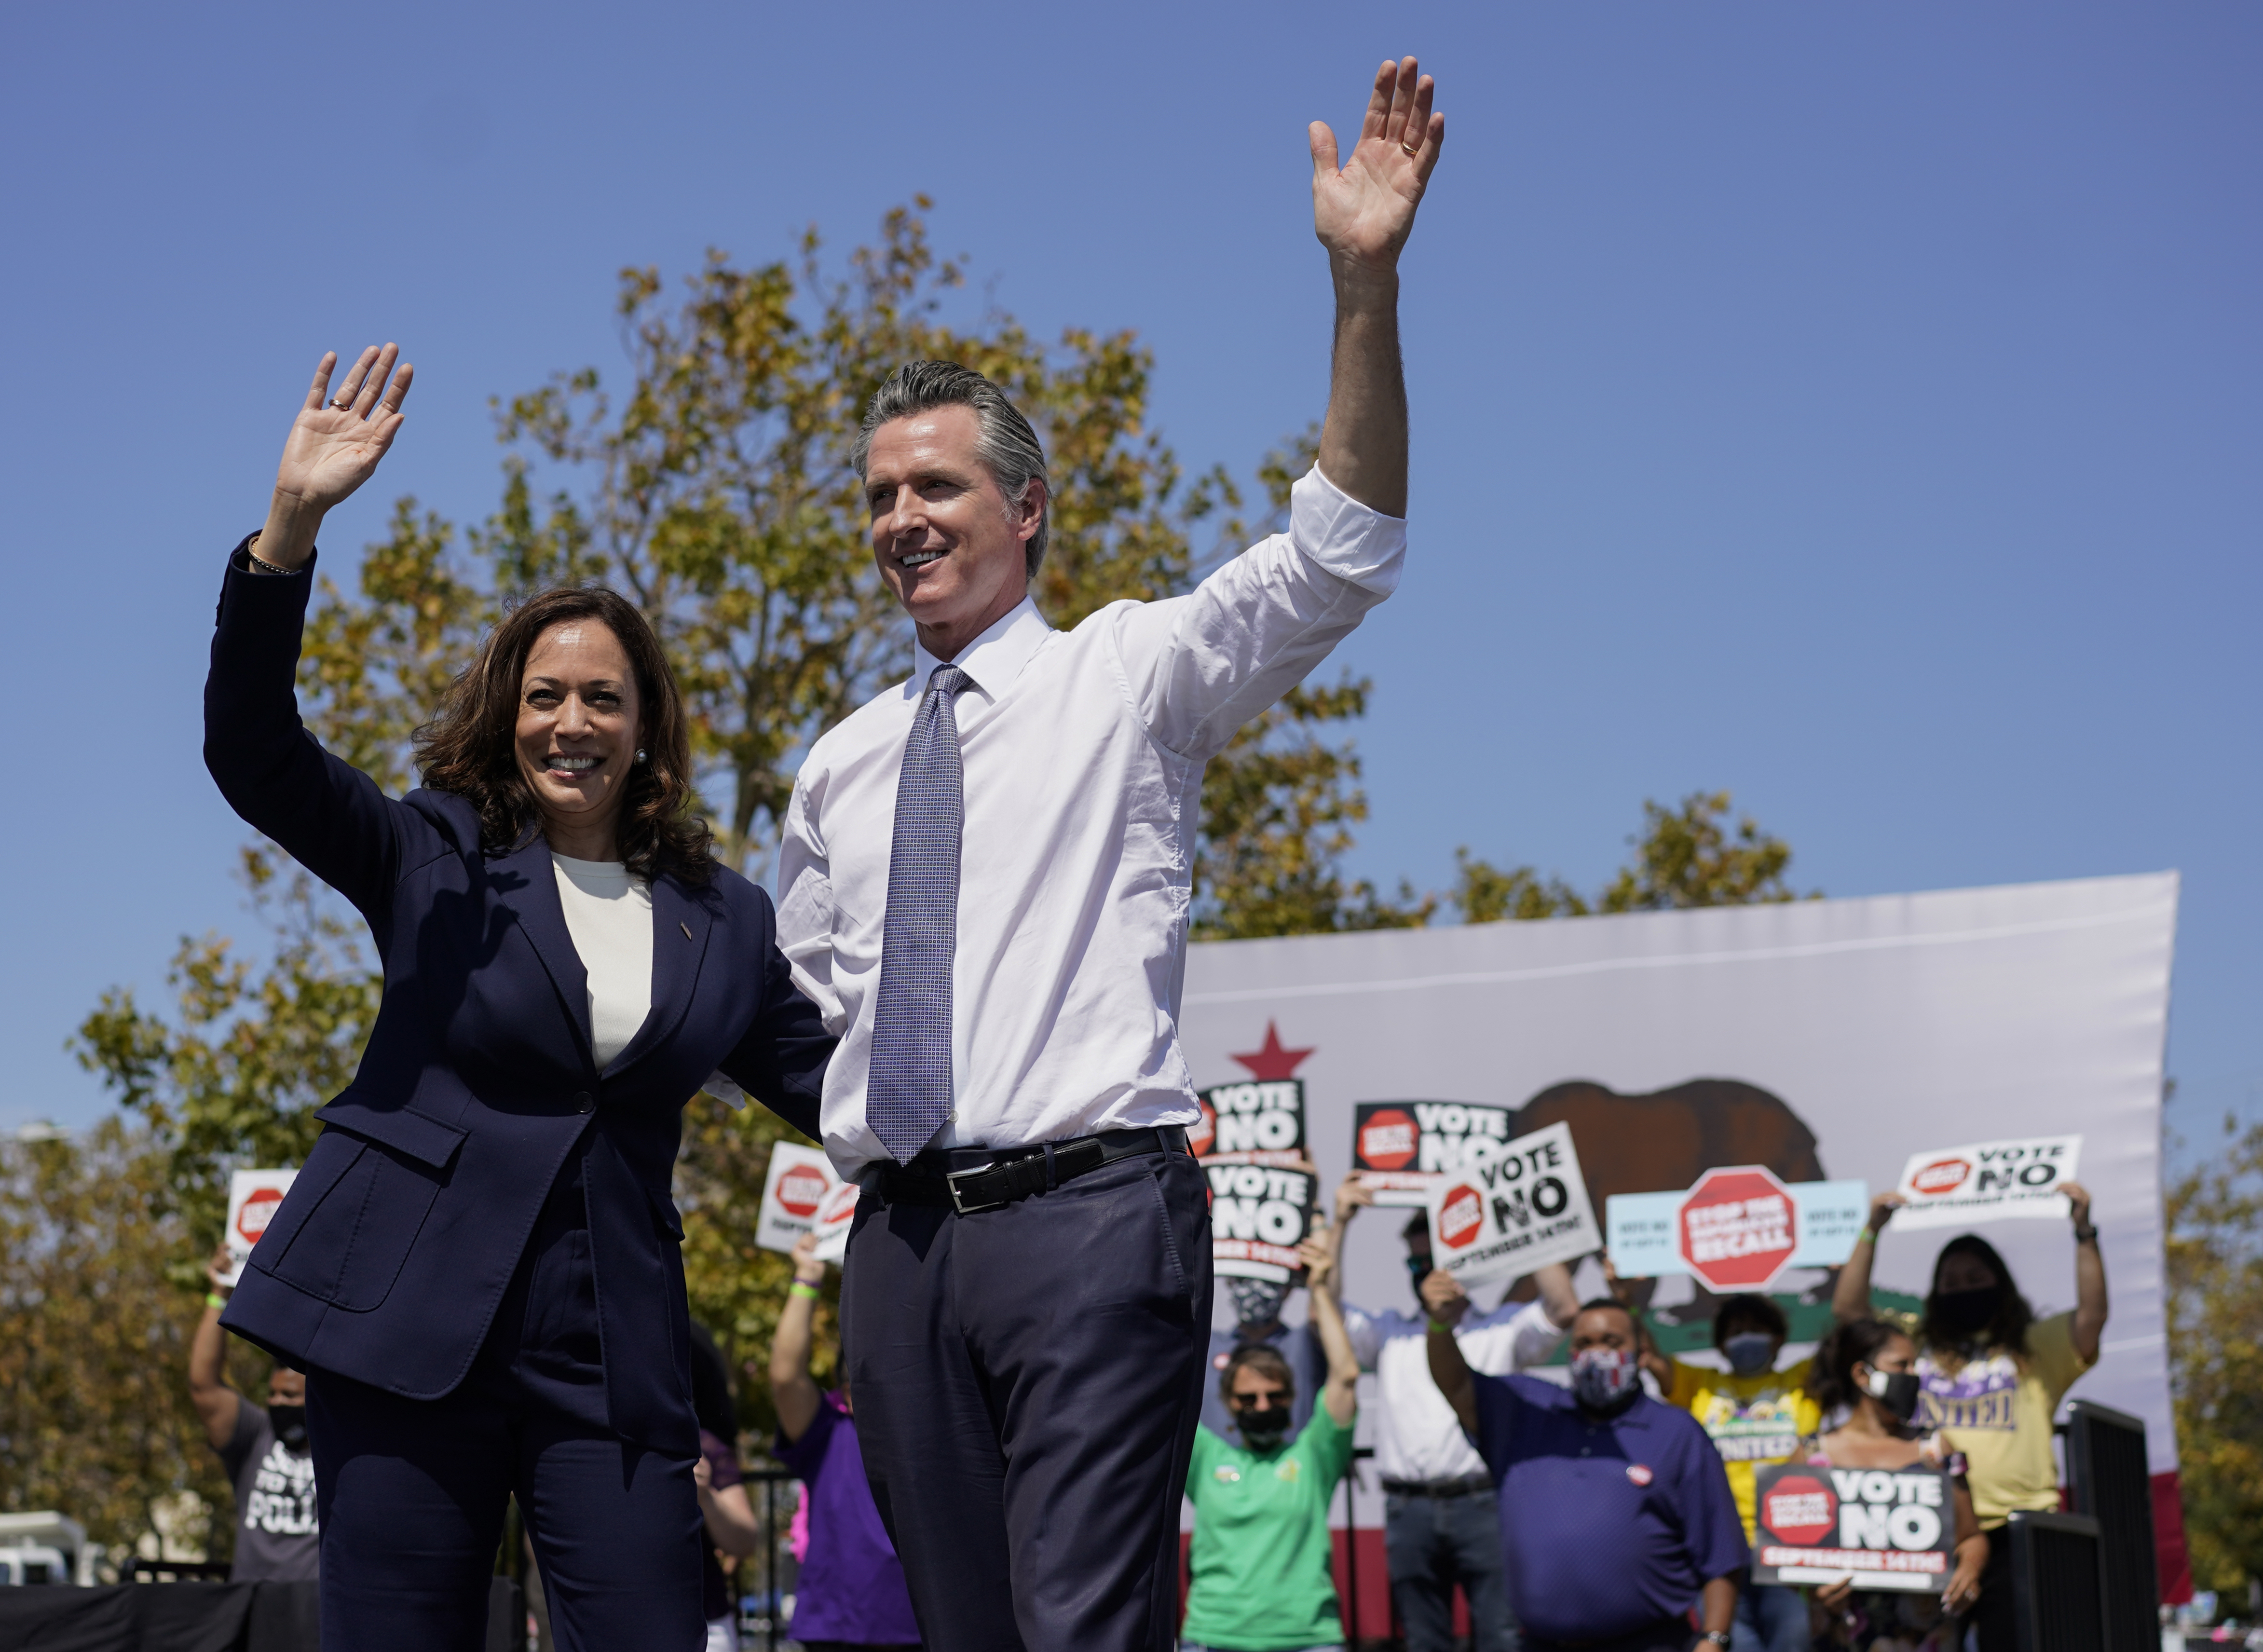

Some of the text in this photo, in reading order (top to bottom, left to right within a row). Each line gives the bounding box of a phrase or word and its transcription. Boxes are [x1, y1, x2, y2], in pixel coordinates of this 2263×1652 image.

[1210, 1081, 1299, 1114] VOTE
[1216, 1110, 1298, 1153] NO
[1414, 1103, 1509, 1138] VOTE
[1419, 1132, 1502, 1172] NO
[1480, 1140, 1562, 1189] VOTE
[1979, 1146, 2064, 1162] VOTE
[1208, 1165, 1308, 1206] VOTE
[1977, 1164, 2057, 1191] NO
[1211, 1197, 1303, 1246] NO
[1492, 1177, 1568, 1235] NO
[1691, 1227, 1793, 1264] RECALL
[1916, 1387, 2015, 1431] NITED
[1830, 1470, 1943, 1507] VOTE
[1839, 1503, 1942, 1551] NO
